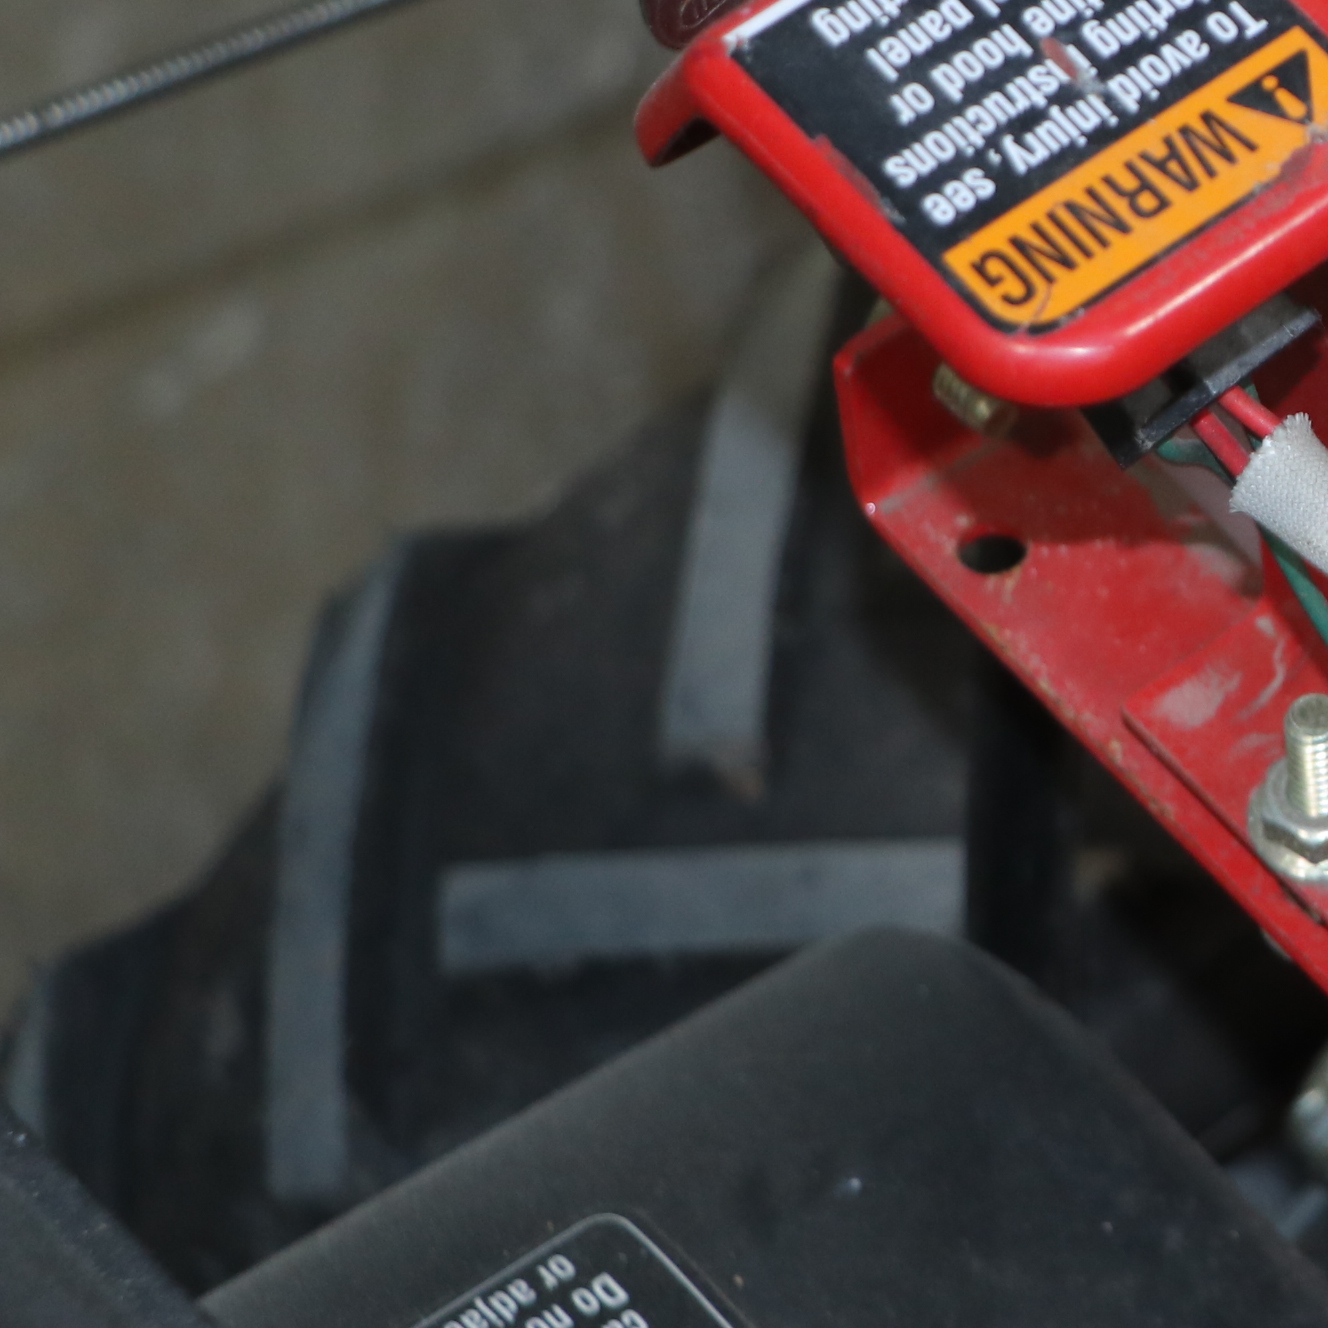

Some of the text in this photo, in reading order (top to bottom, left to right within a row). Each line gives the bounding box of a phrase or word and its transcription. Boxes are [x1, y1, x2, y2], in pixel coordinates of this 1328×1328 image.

[929, 23, 1033, 102] hood
[888, 82, 934, 126] or
[920, 0, 1268, 228] To avoid injury, see
[970, 108, 1260, 309] WARNING
[571, 1273, 630, 1317] Do
